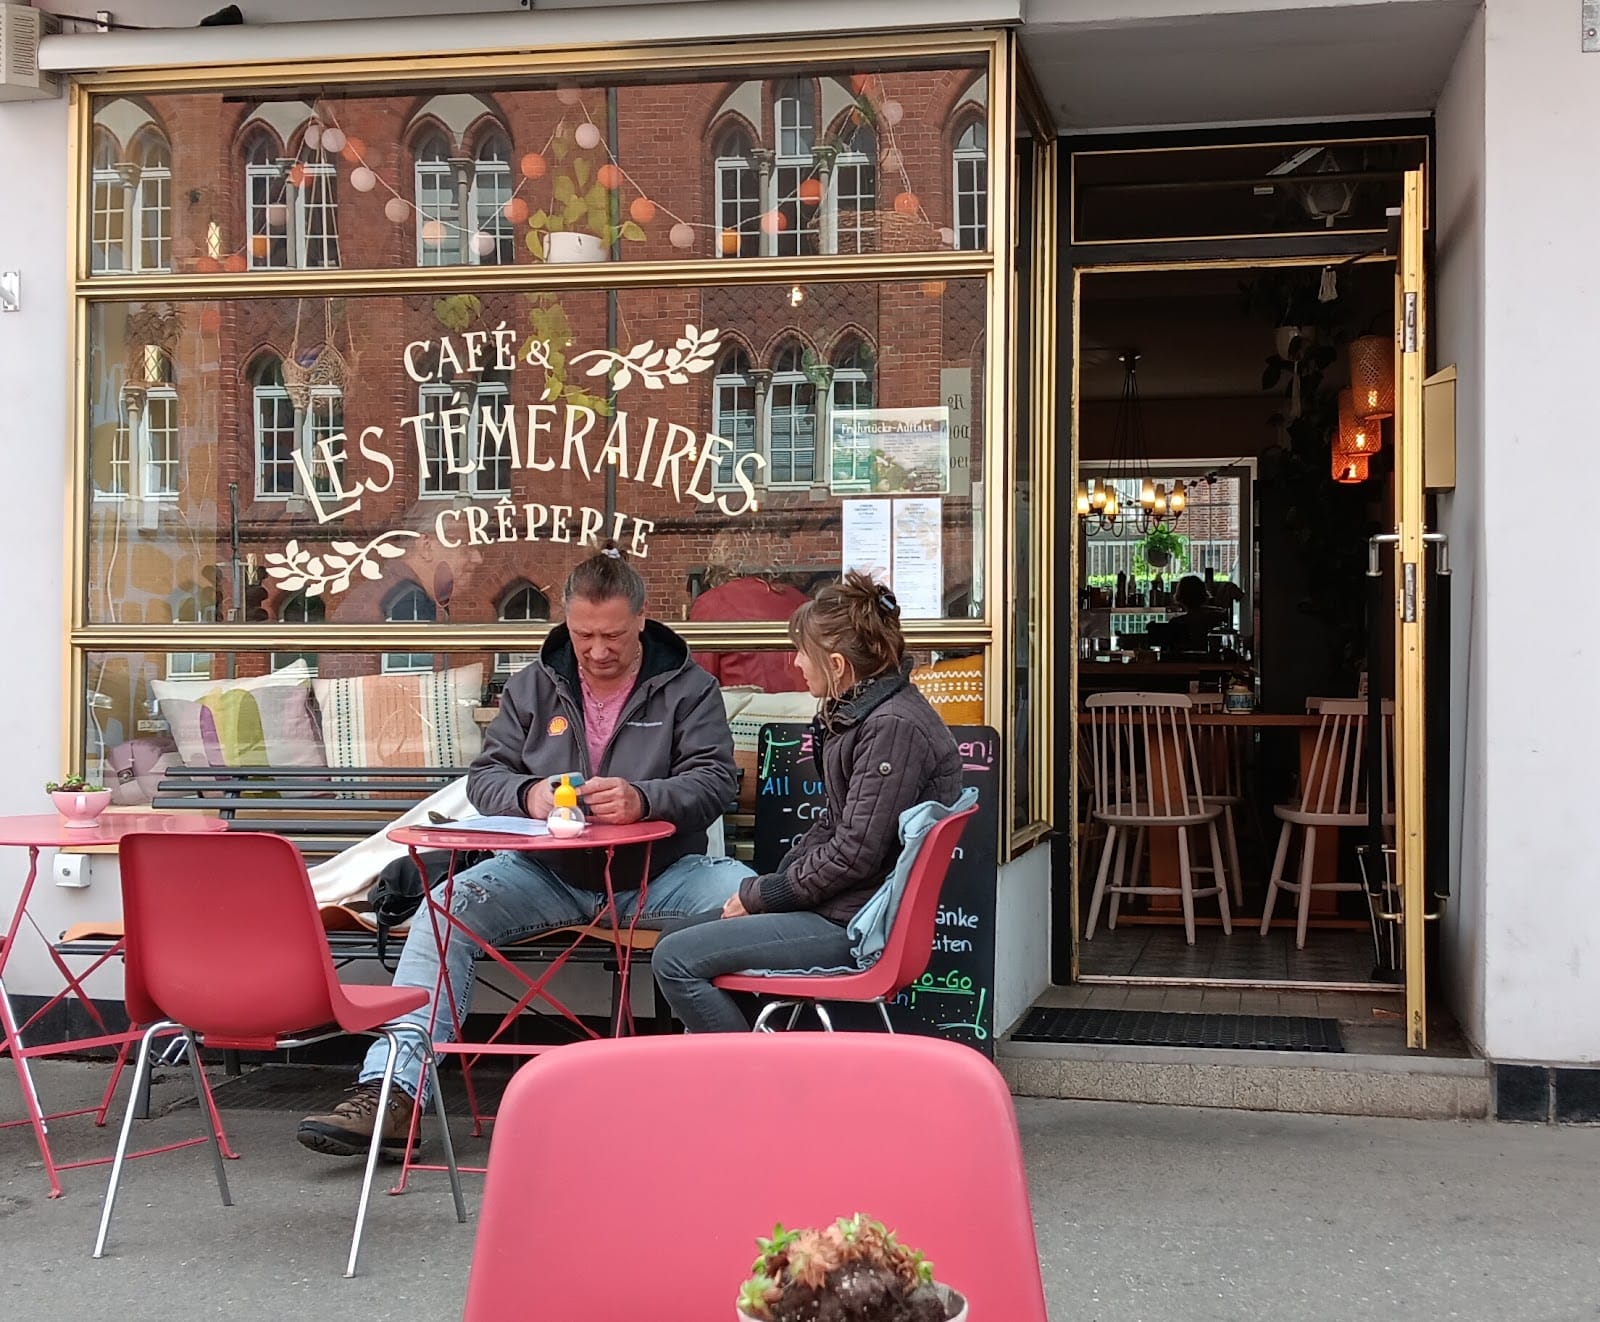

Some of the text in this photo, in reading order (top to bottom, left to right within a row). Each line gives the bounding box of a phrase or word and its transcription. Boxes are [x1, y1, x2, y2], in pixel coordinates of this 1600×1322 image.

[403, 320, 553, 383] CAFÉ &
[290, 388, 767, 524] LES TÉMÉRAIRES
[435, 496, 655, 558] CRÊPERIE
[762, 775, 789, 796] All
[935, 904, 979, 928] änke
[913, 970, 972, 989] o-Go
